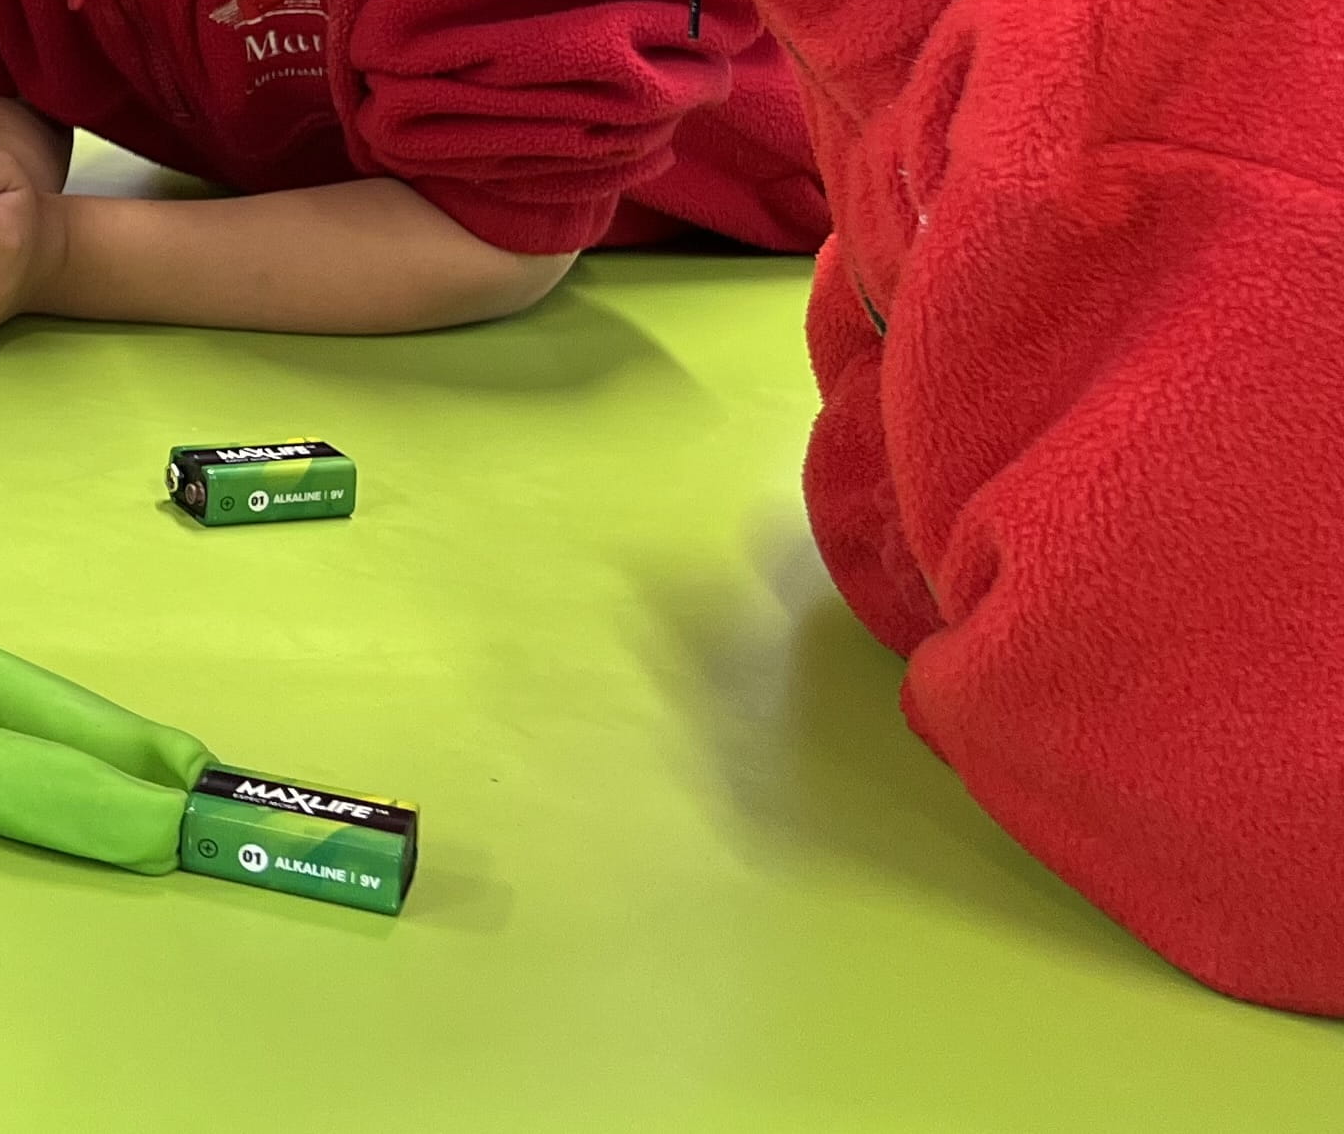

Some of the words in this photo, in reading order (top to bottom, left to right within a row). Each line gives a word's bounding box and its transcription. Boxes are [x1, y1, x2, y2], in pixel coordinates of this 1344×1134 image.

[273, 491, 321, 504] ALKALINE
[330, 489, 344, 500] 9V
[242, 849, 262, 866] 01
[274, 856, 346, 882] ALKALINE
[359, 875, 381, 890] 9V
